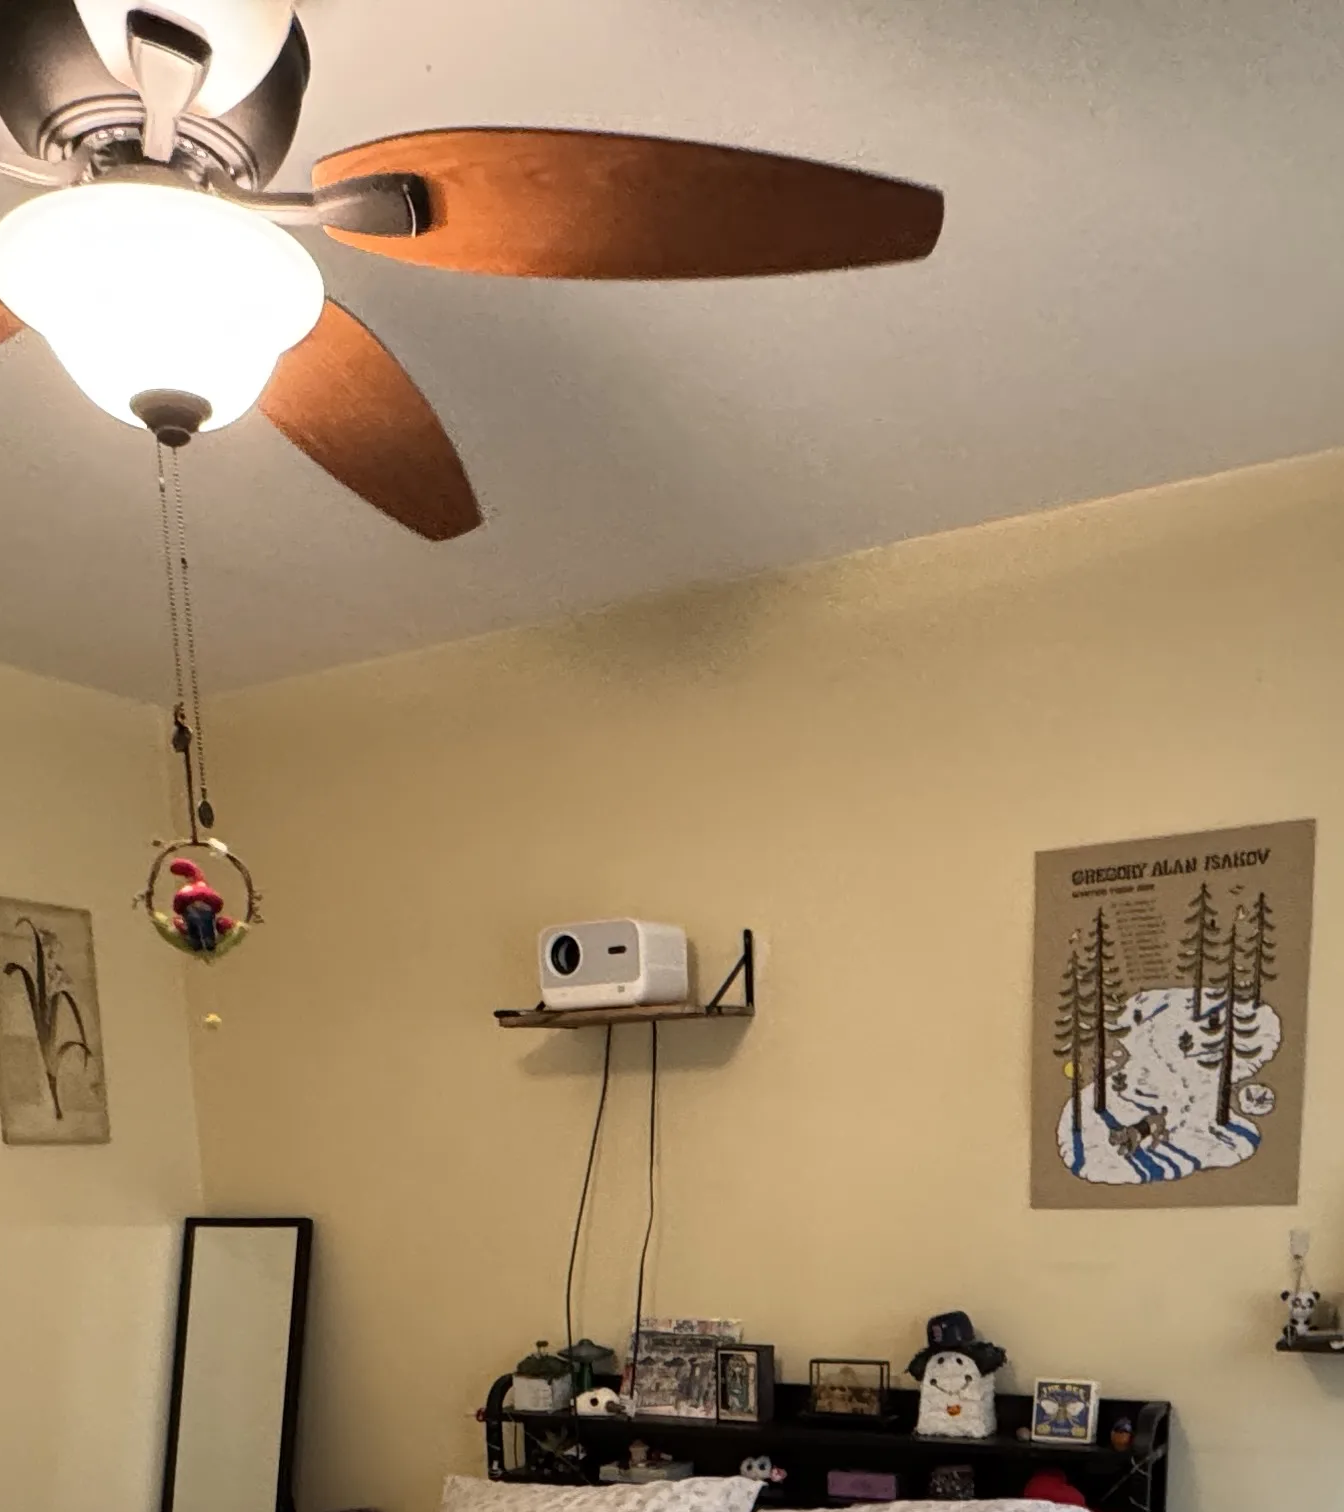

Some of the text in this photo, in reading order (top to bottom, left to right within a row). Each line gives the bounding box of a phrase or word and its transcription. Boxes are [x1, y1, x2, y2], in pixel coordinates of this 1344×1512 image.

[1072, 848, 1272, 886] GREGORY ALAN ISAKOV
